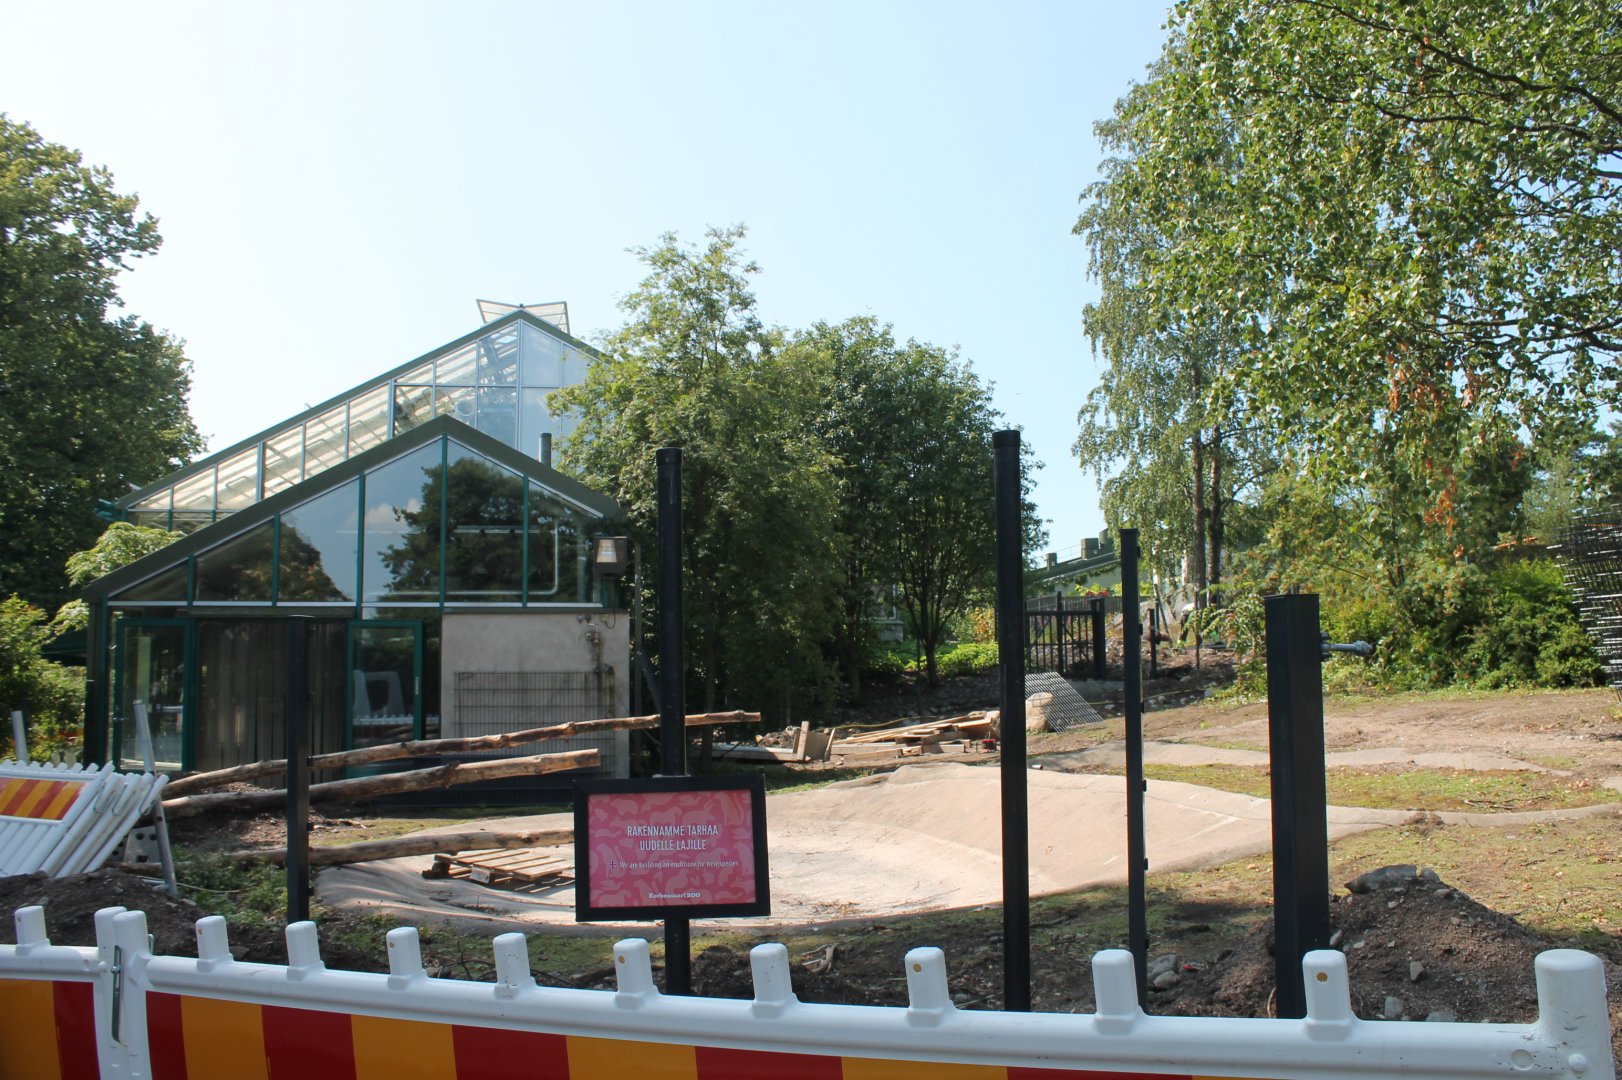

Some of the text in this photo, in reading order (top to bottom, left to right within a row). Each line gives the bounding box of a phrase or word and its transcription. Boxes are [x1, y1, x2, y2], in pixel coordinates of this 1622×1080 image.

[627, 825, 719, 837] RAKENNAMME TARHAA
[639, 839, 706, 851] UUDELLE LAJILLE
[619, 861, 628, 869] We
[639, 861, 661, 870] building
[719, 861, 739, 869] species
